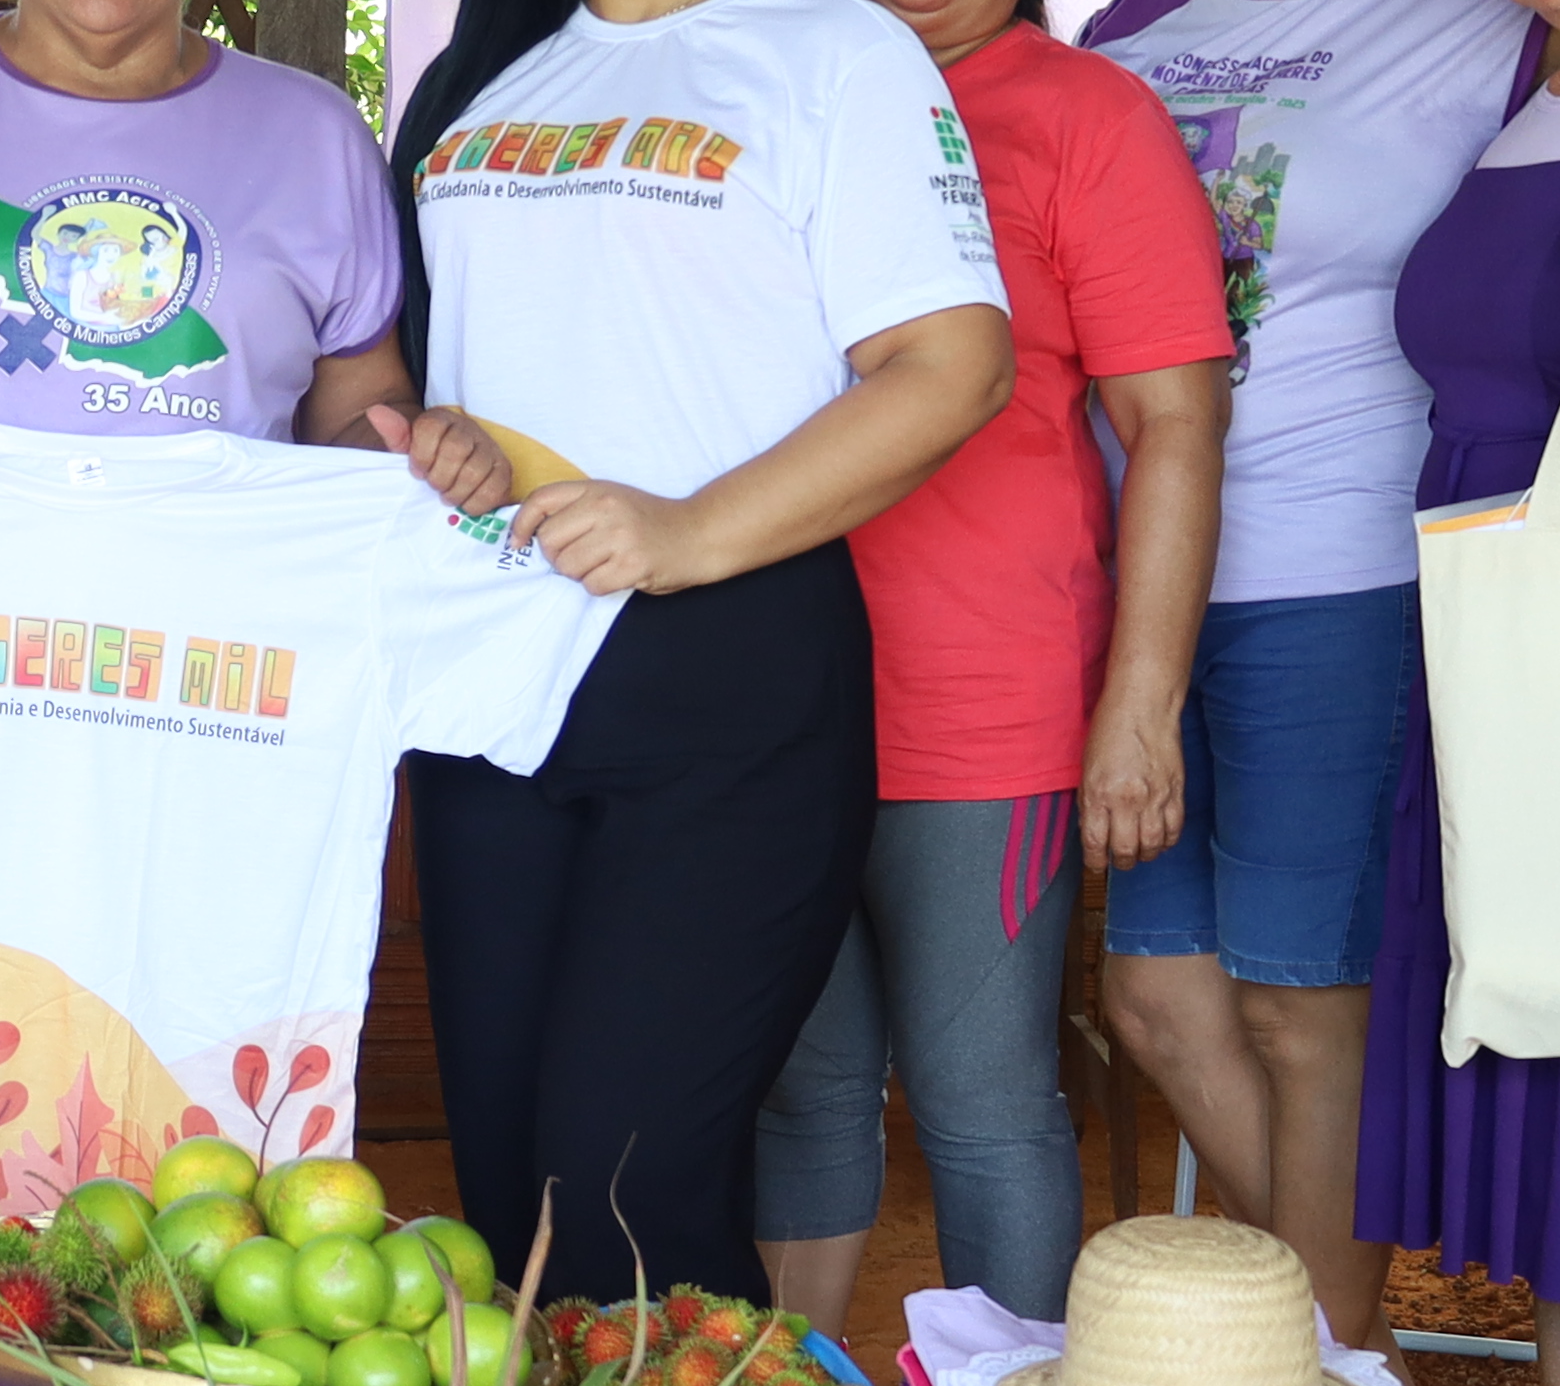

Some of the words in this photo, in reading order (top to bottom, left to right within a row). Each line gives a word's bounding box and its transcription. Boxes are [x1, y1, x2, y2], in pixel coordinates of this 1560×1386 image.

[61, 190, 110, 208] MMC
[116, 191, 161, 212] Acre
[430, 180, 490, 202] Cidadania
[494, 186, 504, 198] e
[507, 178, 623, 200] Desenvolvimento
[628, 179, 725, 211] Sustentável
[18, 246, 56, 320] Movimento
[53, 316, 73, 335] de
[73, 327, 142, 345] Mulheres
[142, 252, 198, 334] Camponesas
[82, 383, 130, 412] 35
[139, 385, 222, 423] Anos
[29, 704, 39, 718] e
[43, 700, 185, 734] Desenvolvimento
[187, 717, 285, 747] Sustentável
